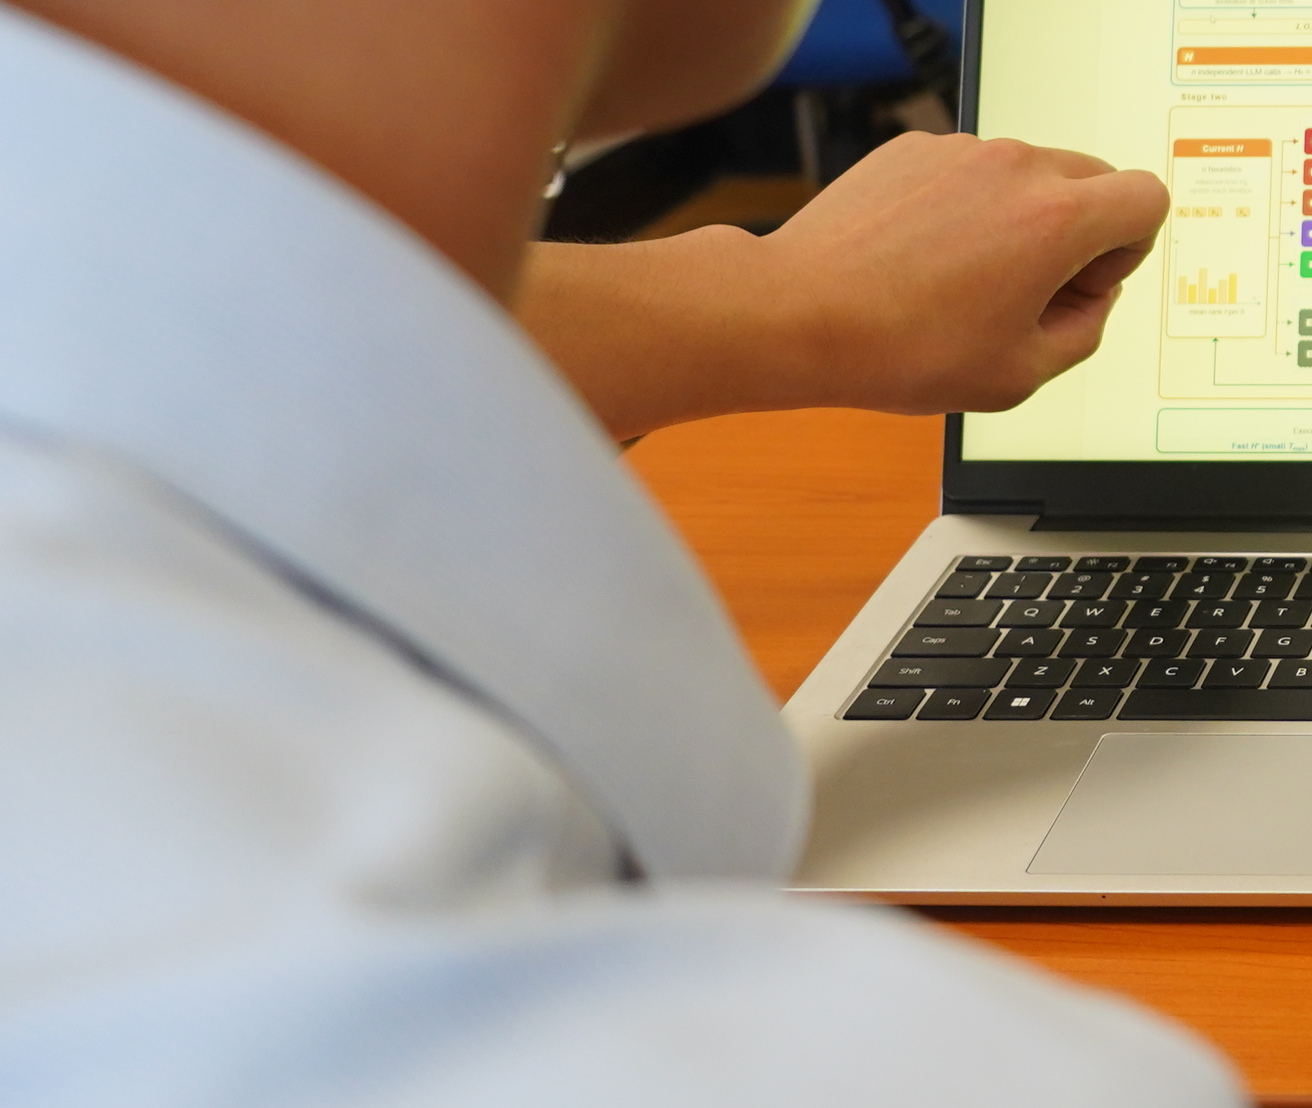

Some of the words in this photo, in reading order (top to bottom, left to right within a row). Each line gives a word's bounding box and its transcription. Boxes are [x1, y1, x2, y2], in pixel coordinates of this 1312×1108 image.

[1182, 93, 1207, 102] Stage
[1203, 145, 1234, 153] Current
[944, 608, 960, 616] Tab
[922, 636, 946, 644] Caps
